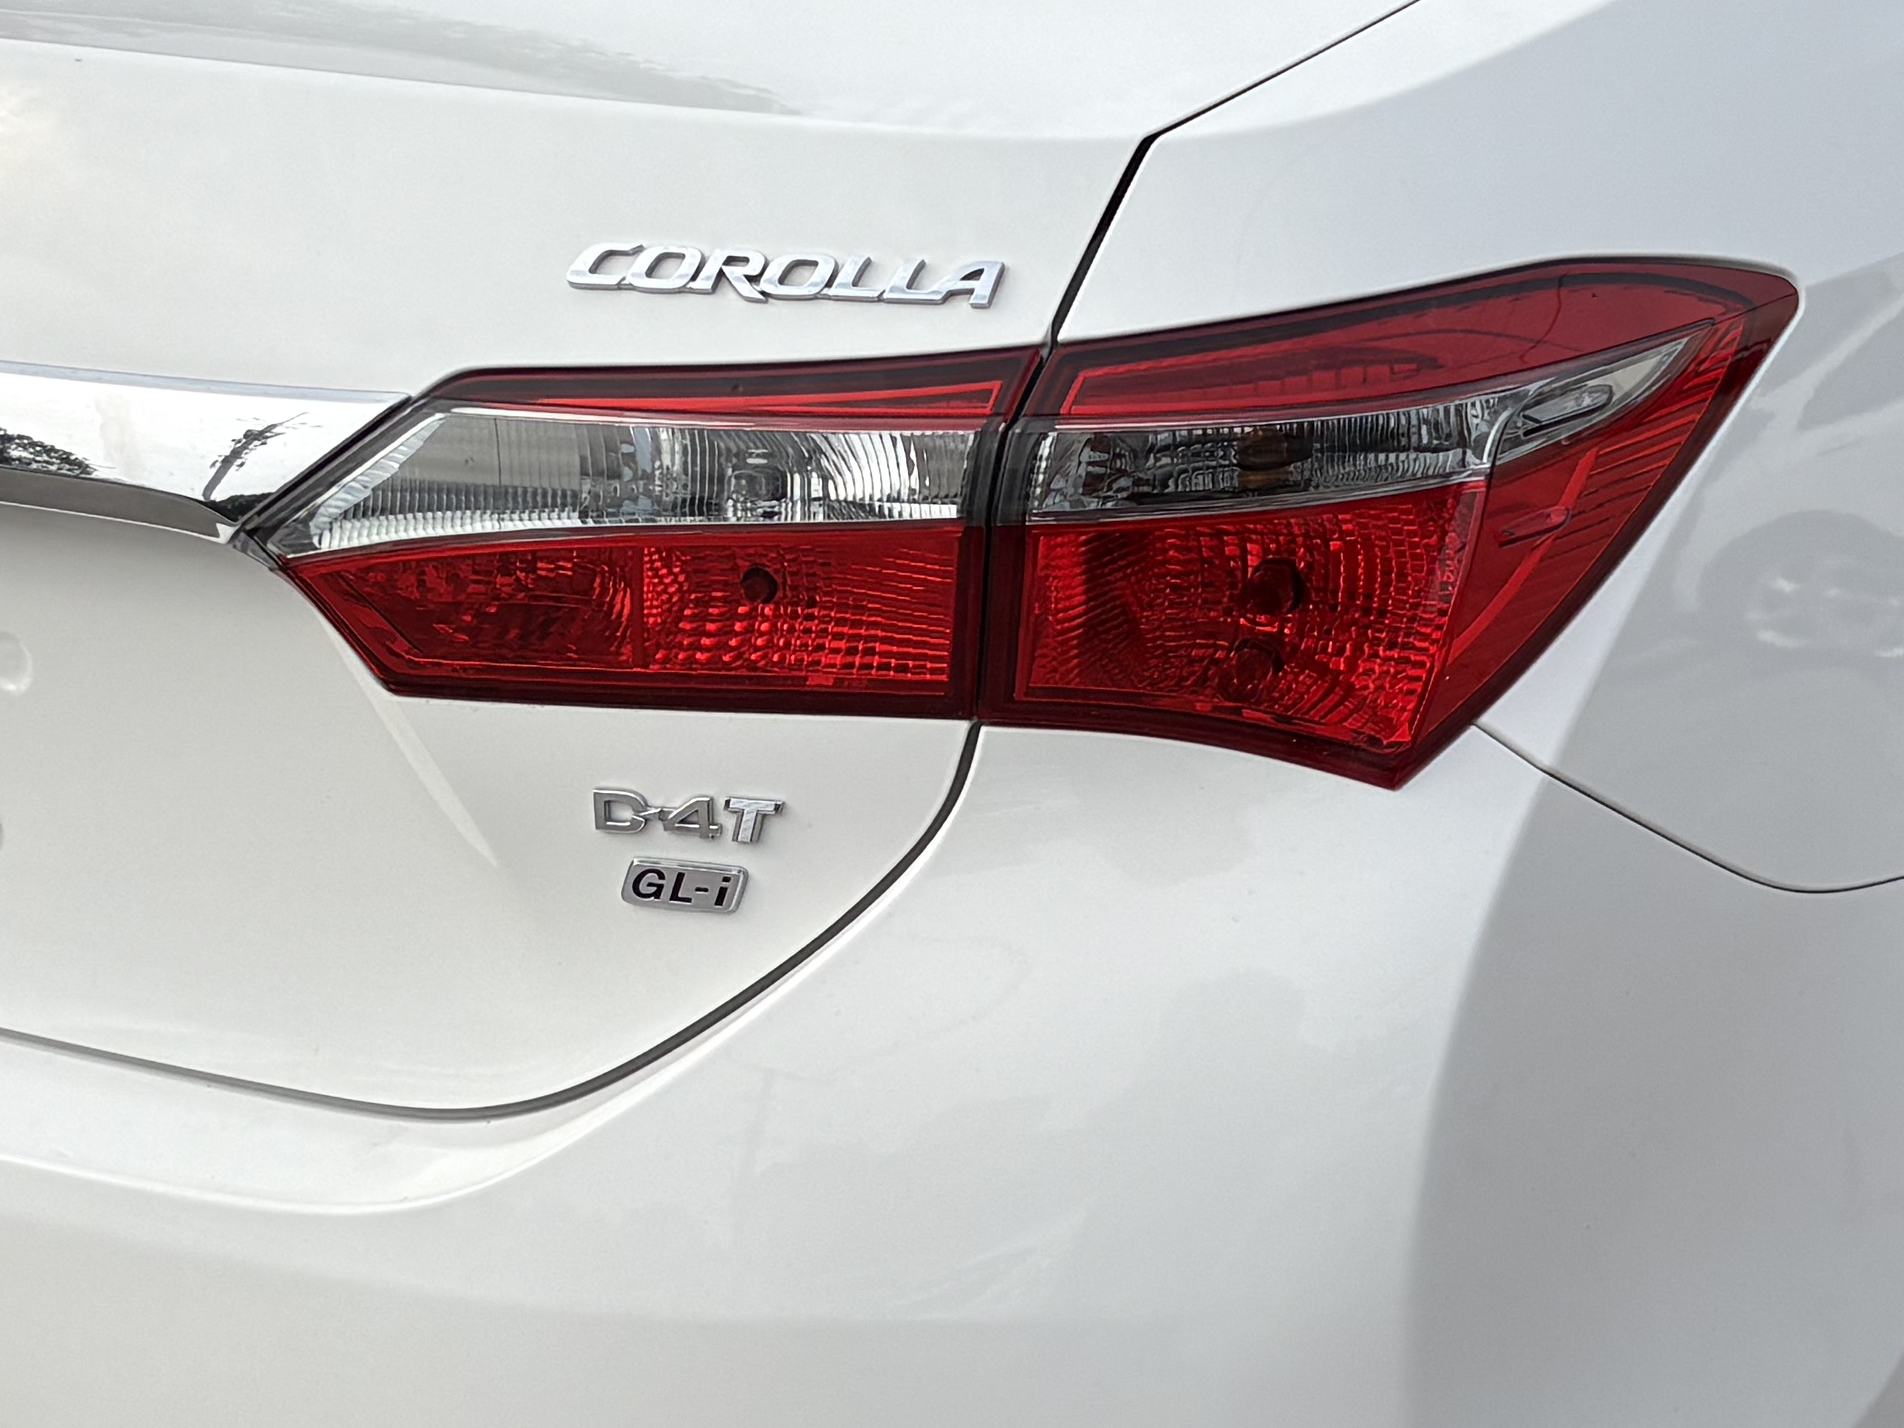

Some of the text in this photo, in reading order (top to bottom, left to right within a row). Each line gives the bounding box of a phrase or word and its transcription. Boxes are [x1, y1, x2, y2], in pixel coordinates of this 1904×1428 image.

[566, 242, 1004, 310] COROLLA
[593, 788, 784, 843] D-4T
[631, 868, 732, 907] GL-i
